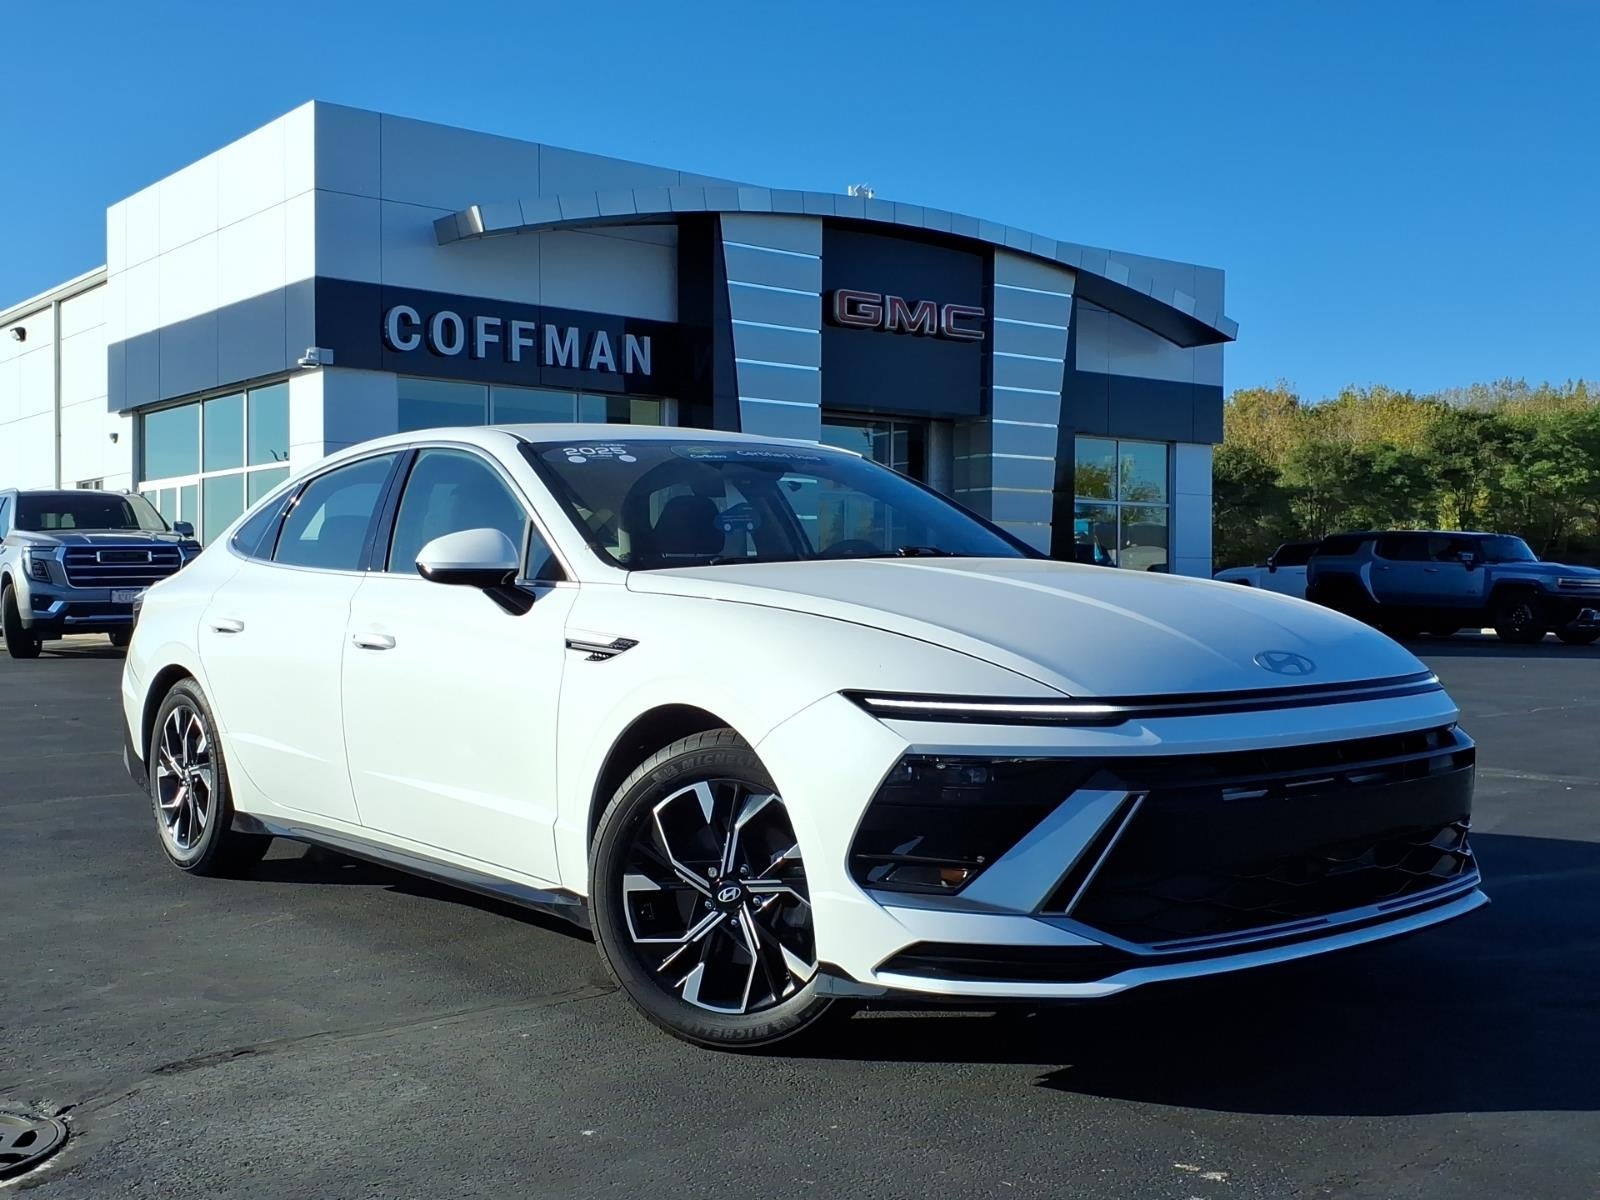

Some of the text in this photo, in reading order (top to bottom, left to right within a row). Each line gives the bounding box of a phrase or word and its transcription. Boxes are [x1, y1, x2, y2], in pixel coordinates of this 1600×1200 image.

[833, 288, 985, 339] GMC
[384, 304, 651, 376] COFFMAN
[562, 446, 627, 456] 2025
